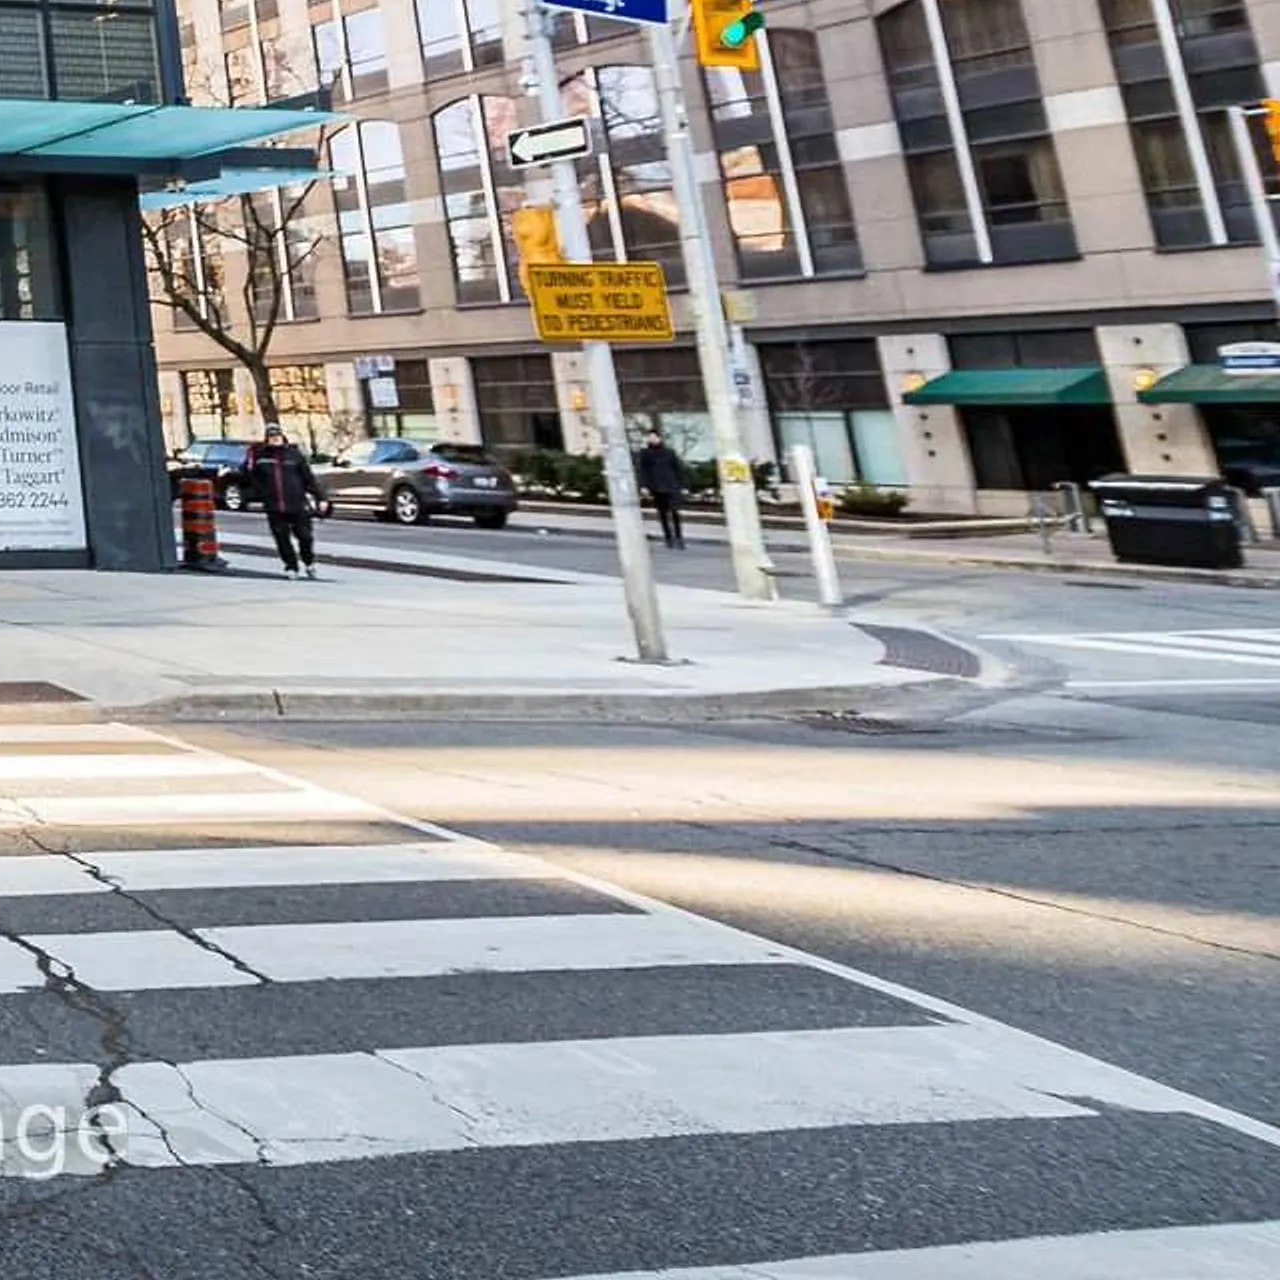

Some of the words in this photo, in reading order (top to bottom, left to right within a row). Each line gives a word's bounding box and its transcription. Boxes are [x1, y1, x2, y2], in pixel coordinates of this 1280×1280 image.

[533, 271, 593, 288] TURNING
[598, 271, 658, 288] TRAFFIC
[555, 292, 593, 309] MUST
[602, 292, 643, 309] YIELD
[543, 314, 562, 331] TO
[566, 314, 666, 331] PEDESTRIANS
[24, 382, 60, 395] Retail
[30, 493, 69, 509] 2244
